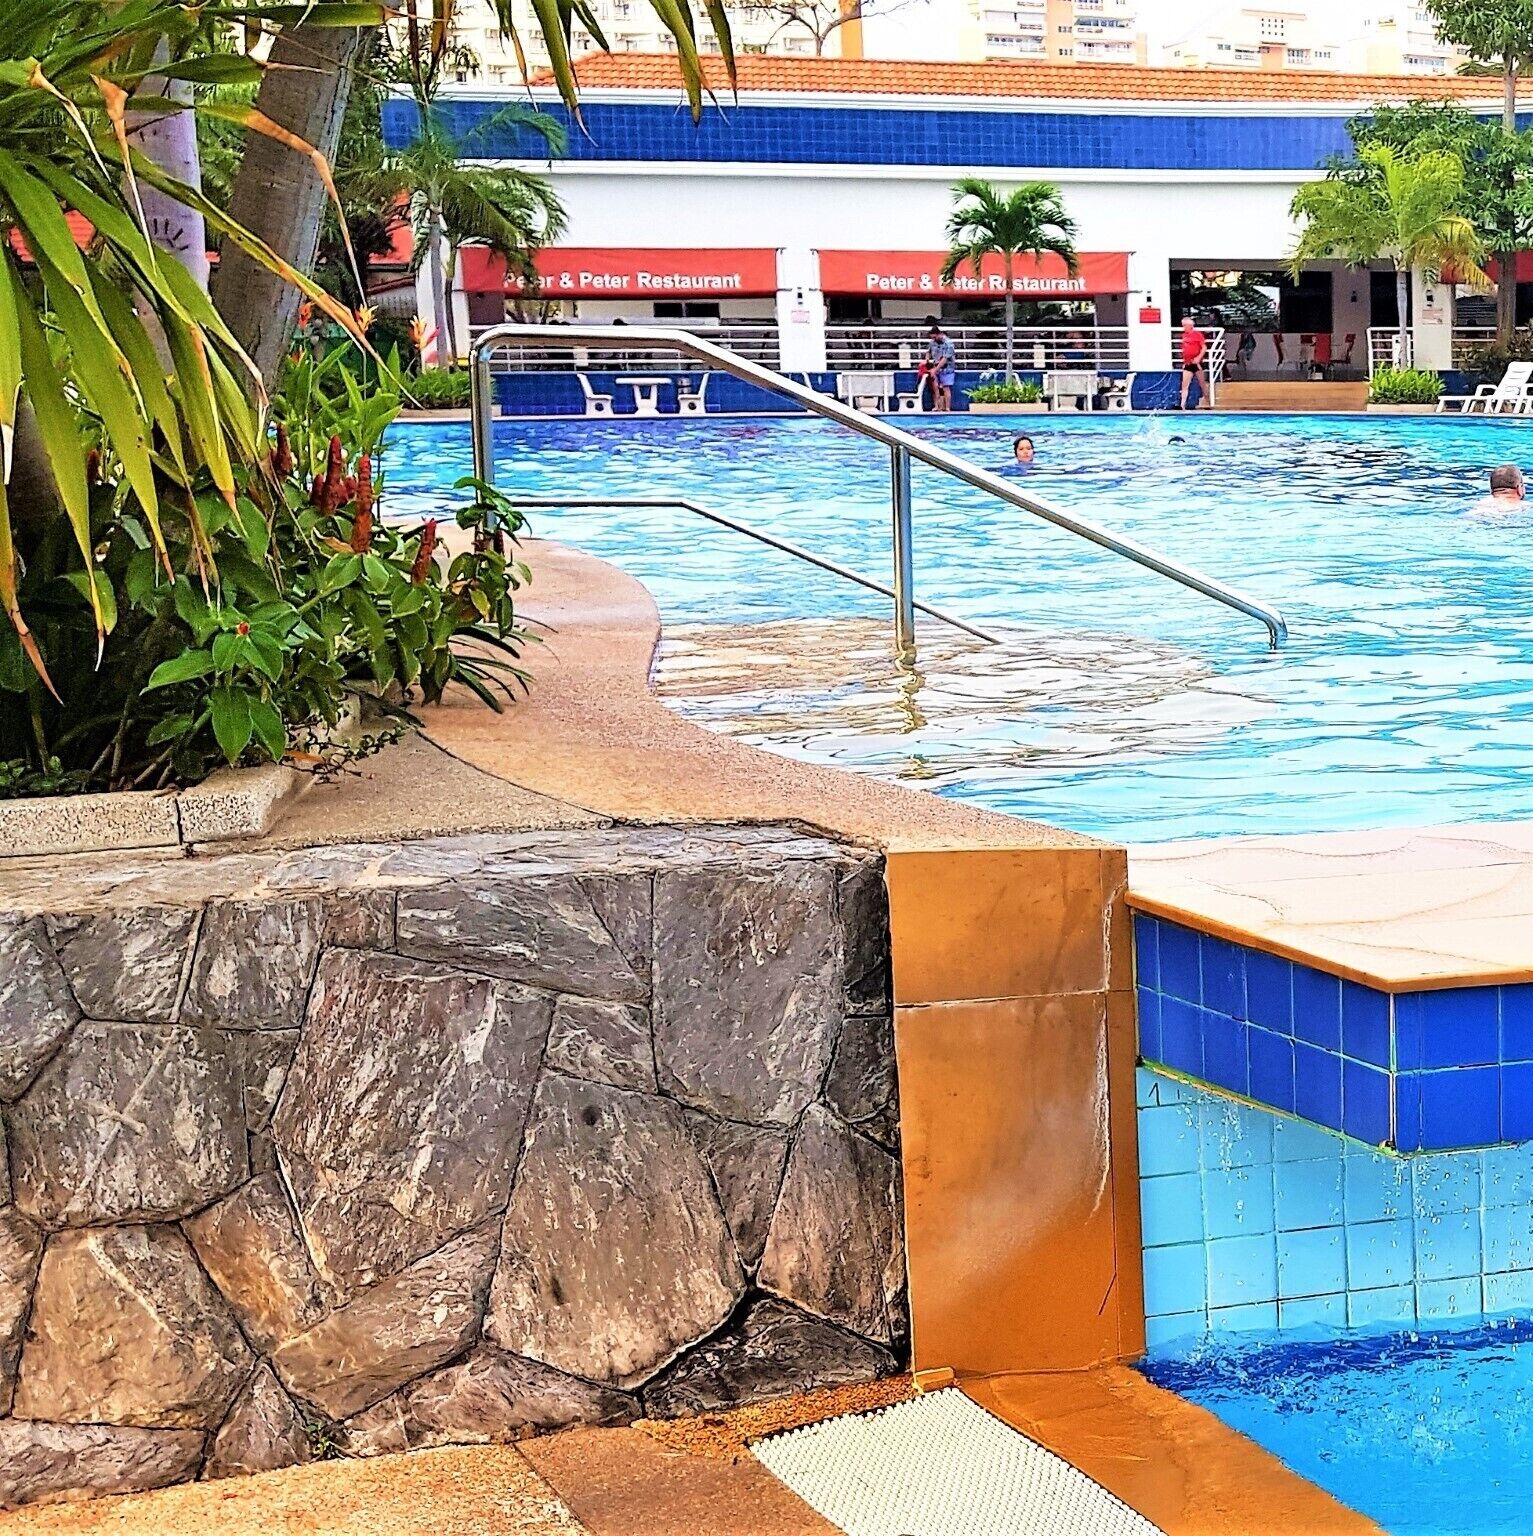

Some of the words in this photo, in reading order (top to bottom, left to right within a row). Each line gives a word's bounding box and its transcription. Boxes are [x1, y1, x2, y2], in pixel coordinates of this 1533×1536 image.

[503, 271, 554, 289] Peer
[560, 271, 575, 289] &
[579, 271, 630, 289] Peter
[637, 271, 742, 289] Restaurant
[866, 273, 915, 291] Peter
[919, 273, 934, 291] &
